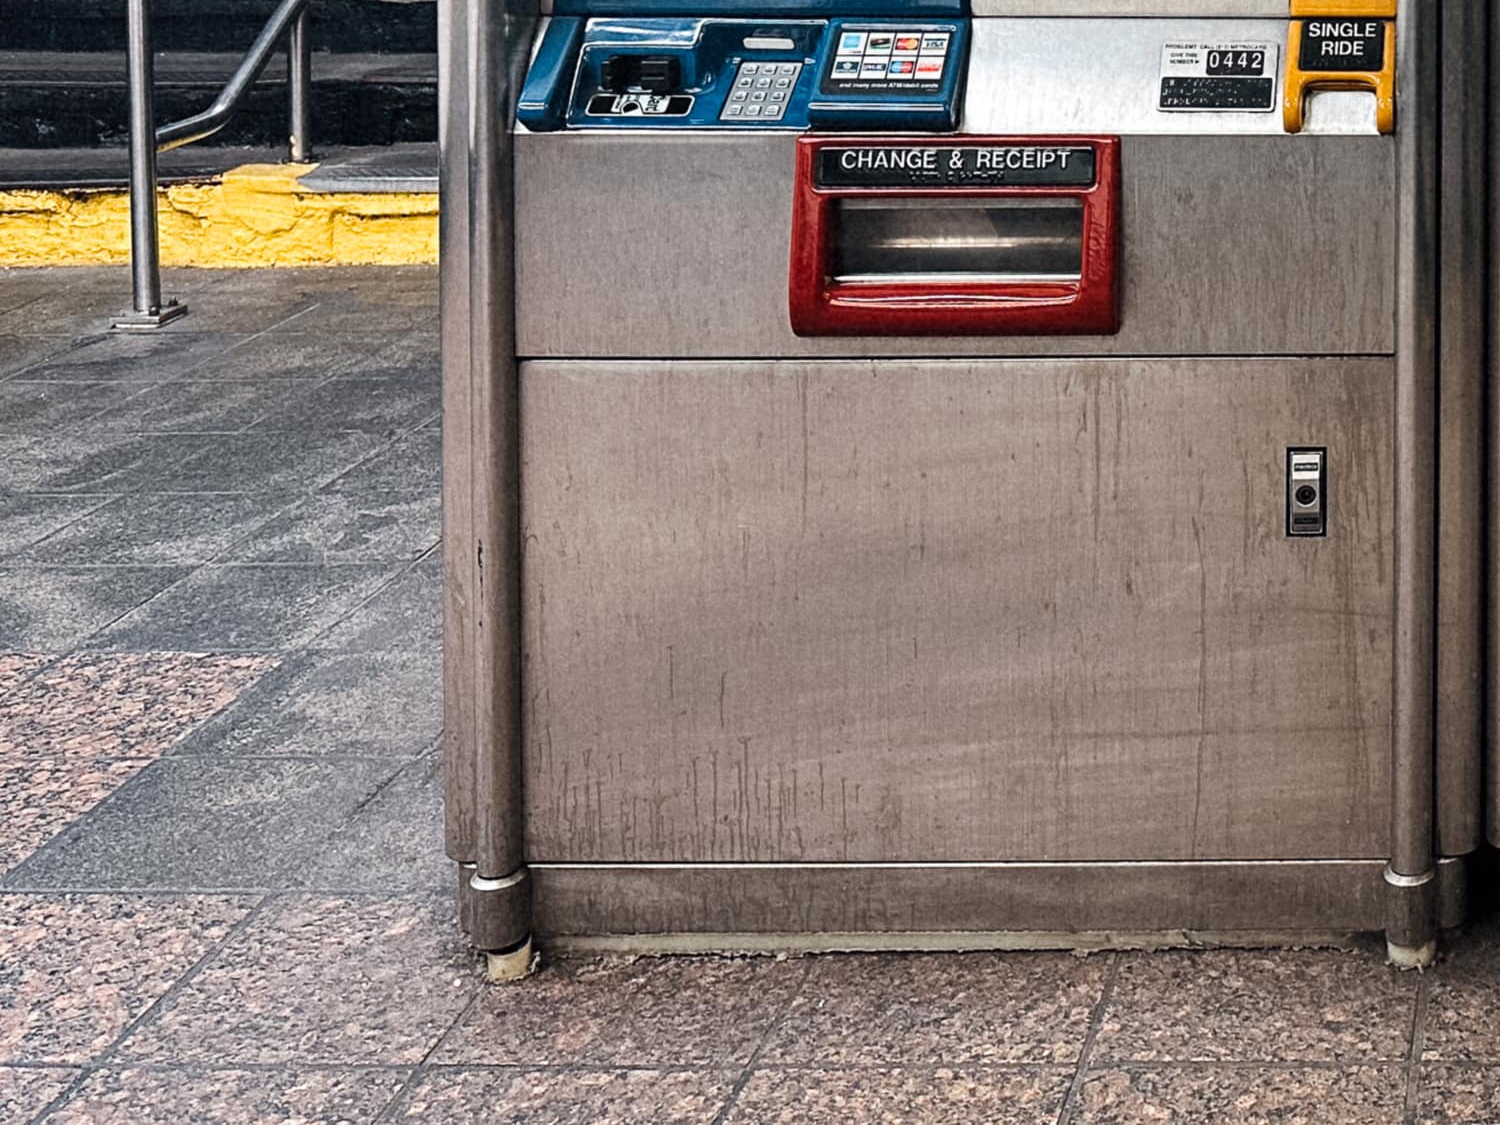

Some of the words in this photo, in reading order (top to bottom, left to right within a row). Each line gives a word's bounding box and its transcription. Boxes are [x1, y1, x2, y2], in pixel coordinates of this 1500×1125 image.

[1309, 23, 1377, 38] SINGLE
[1321, 41, 1364, 56] RIDE
[1209, 52, 1262, 68] 0442
[841, 151, 936, 169] CHANGE
[949, 151, 964, 169] &
[977, 151, 1071, 169] RECEIPT
